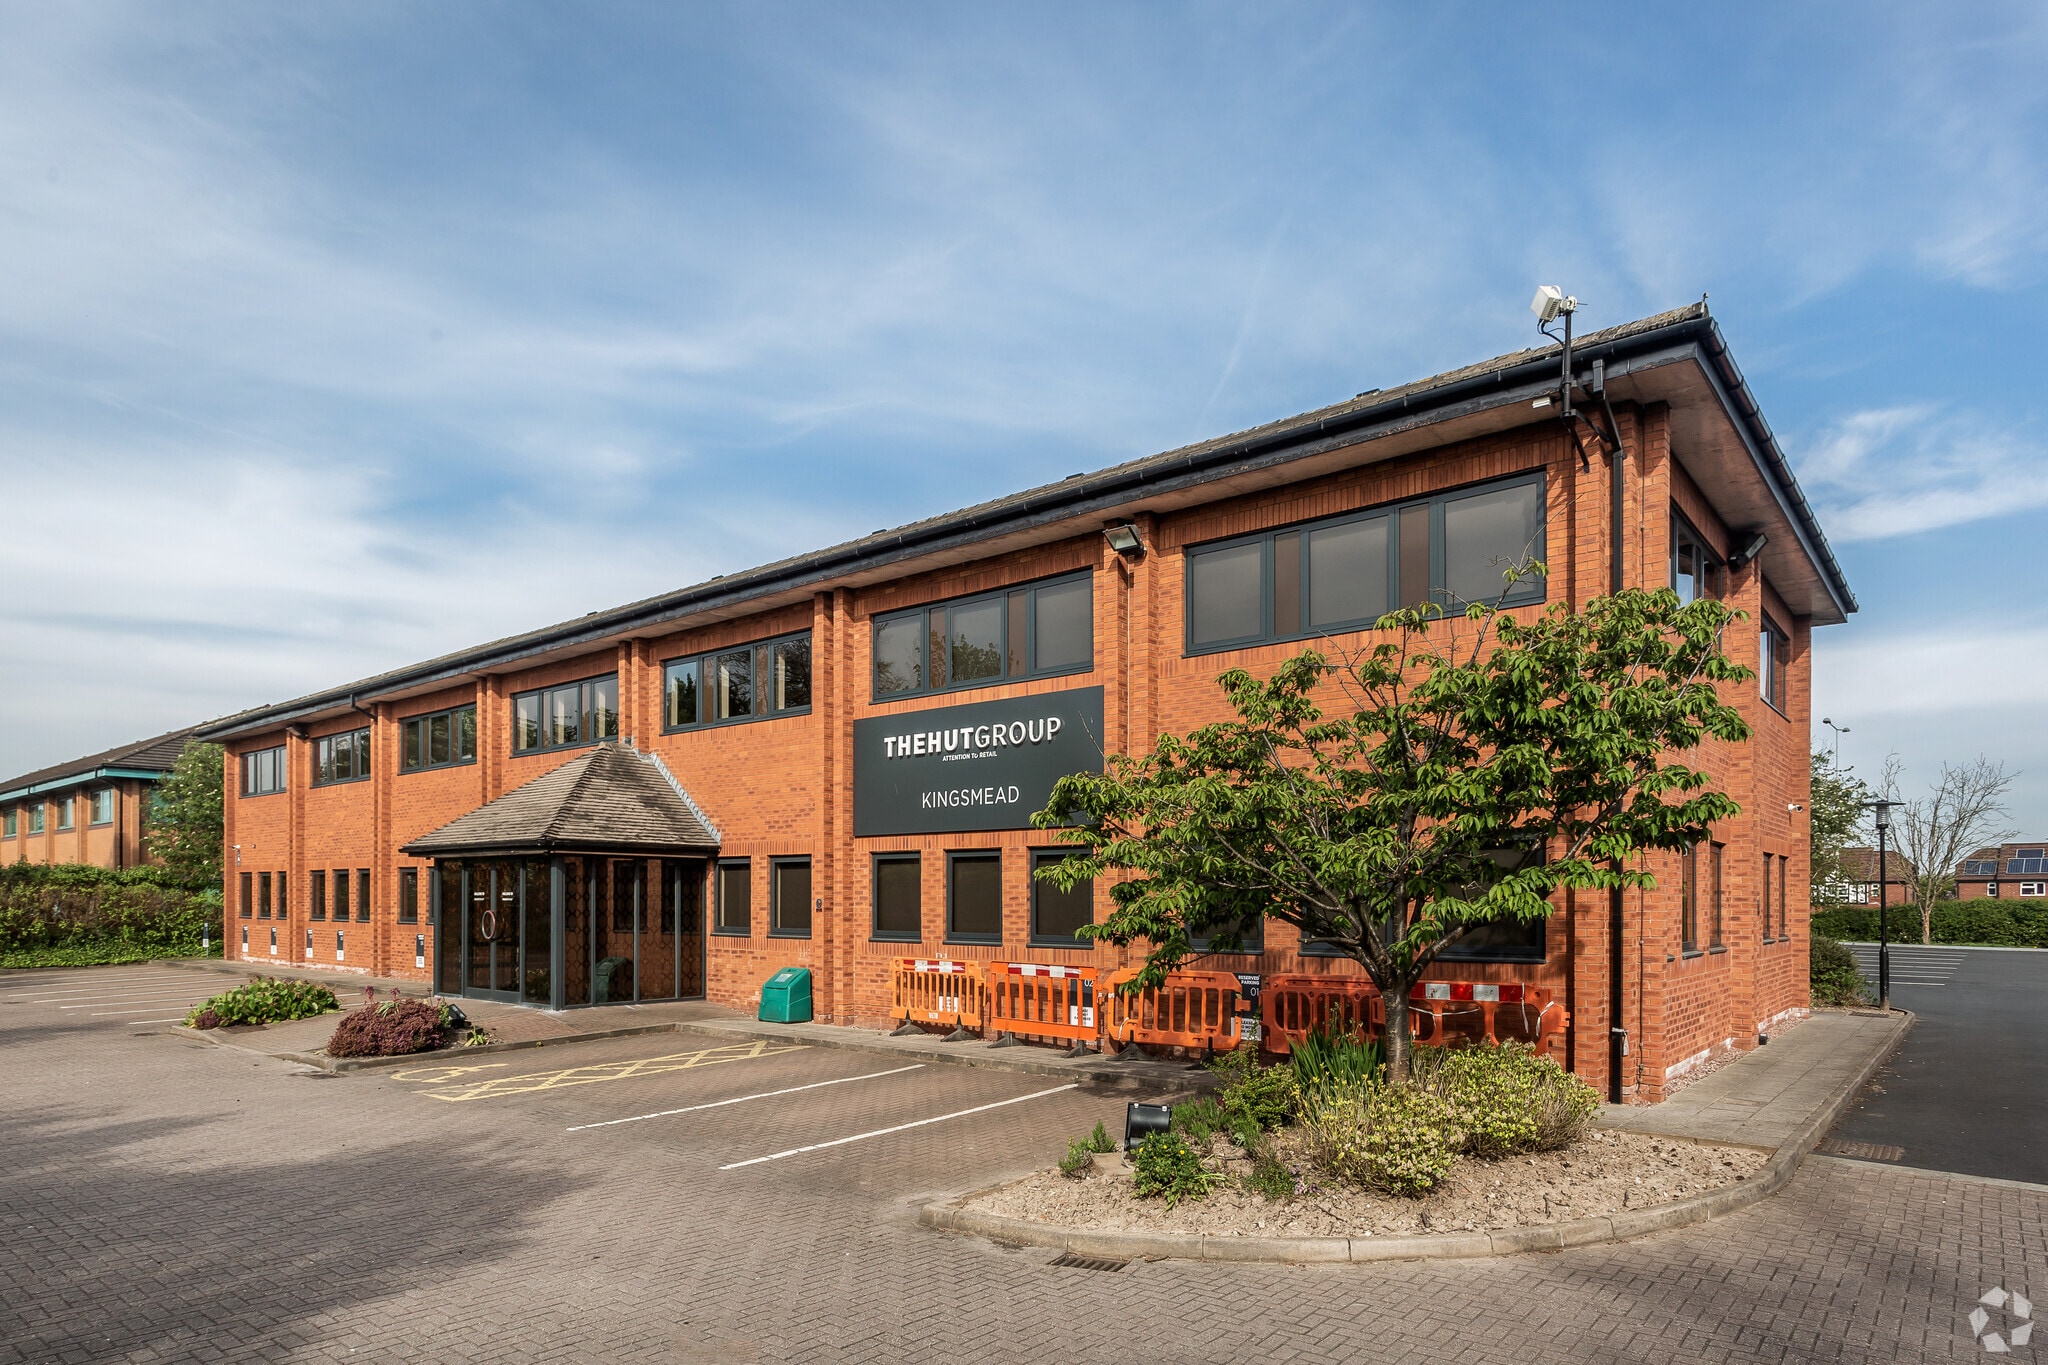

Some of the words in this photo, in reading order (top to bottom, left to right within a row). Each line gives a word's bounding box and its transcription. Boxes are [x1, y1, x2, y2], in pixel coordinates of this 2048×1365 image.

[884, 717, 1061, 758] THEHUTGROUP
[942, 753, 970, 762] ATTENTION
[979, 750, 998, 758] RETAIL
[922, 785, 1020, 809] KINGSMEAD
[1250, 987, 1259, 997] 01
